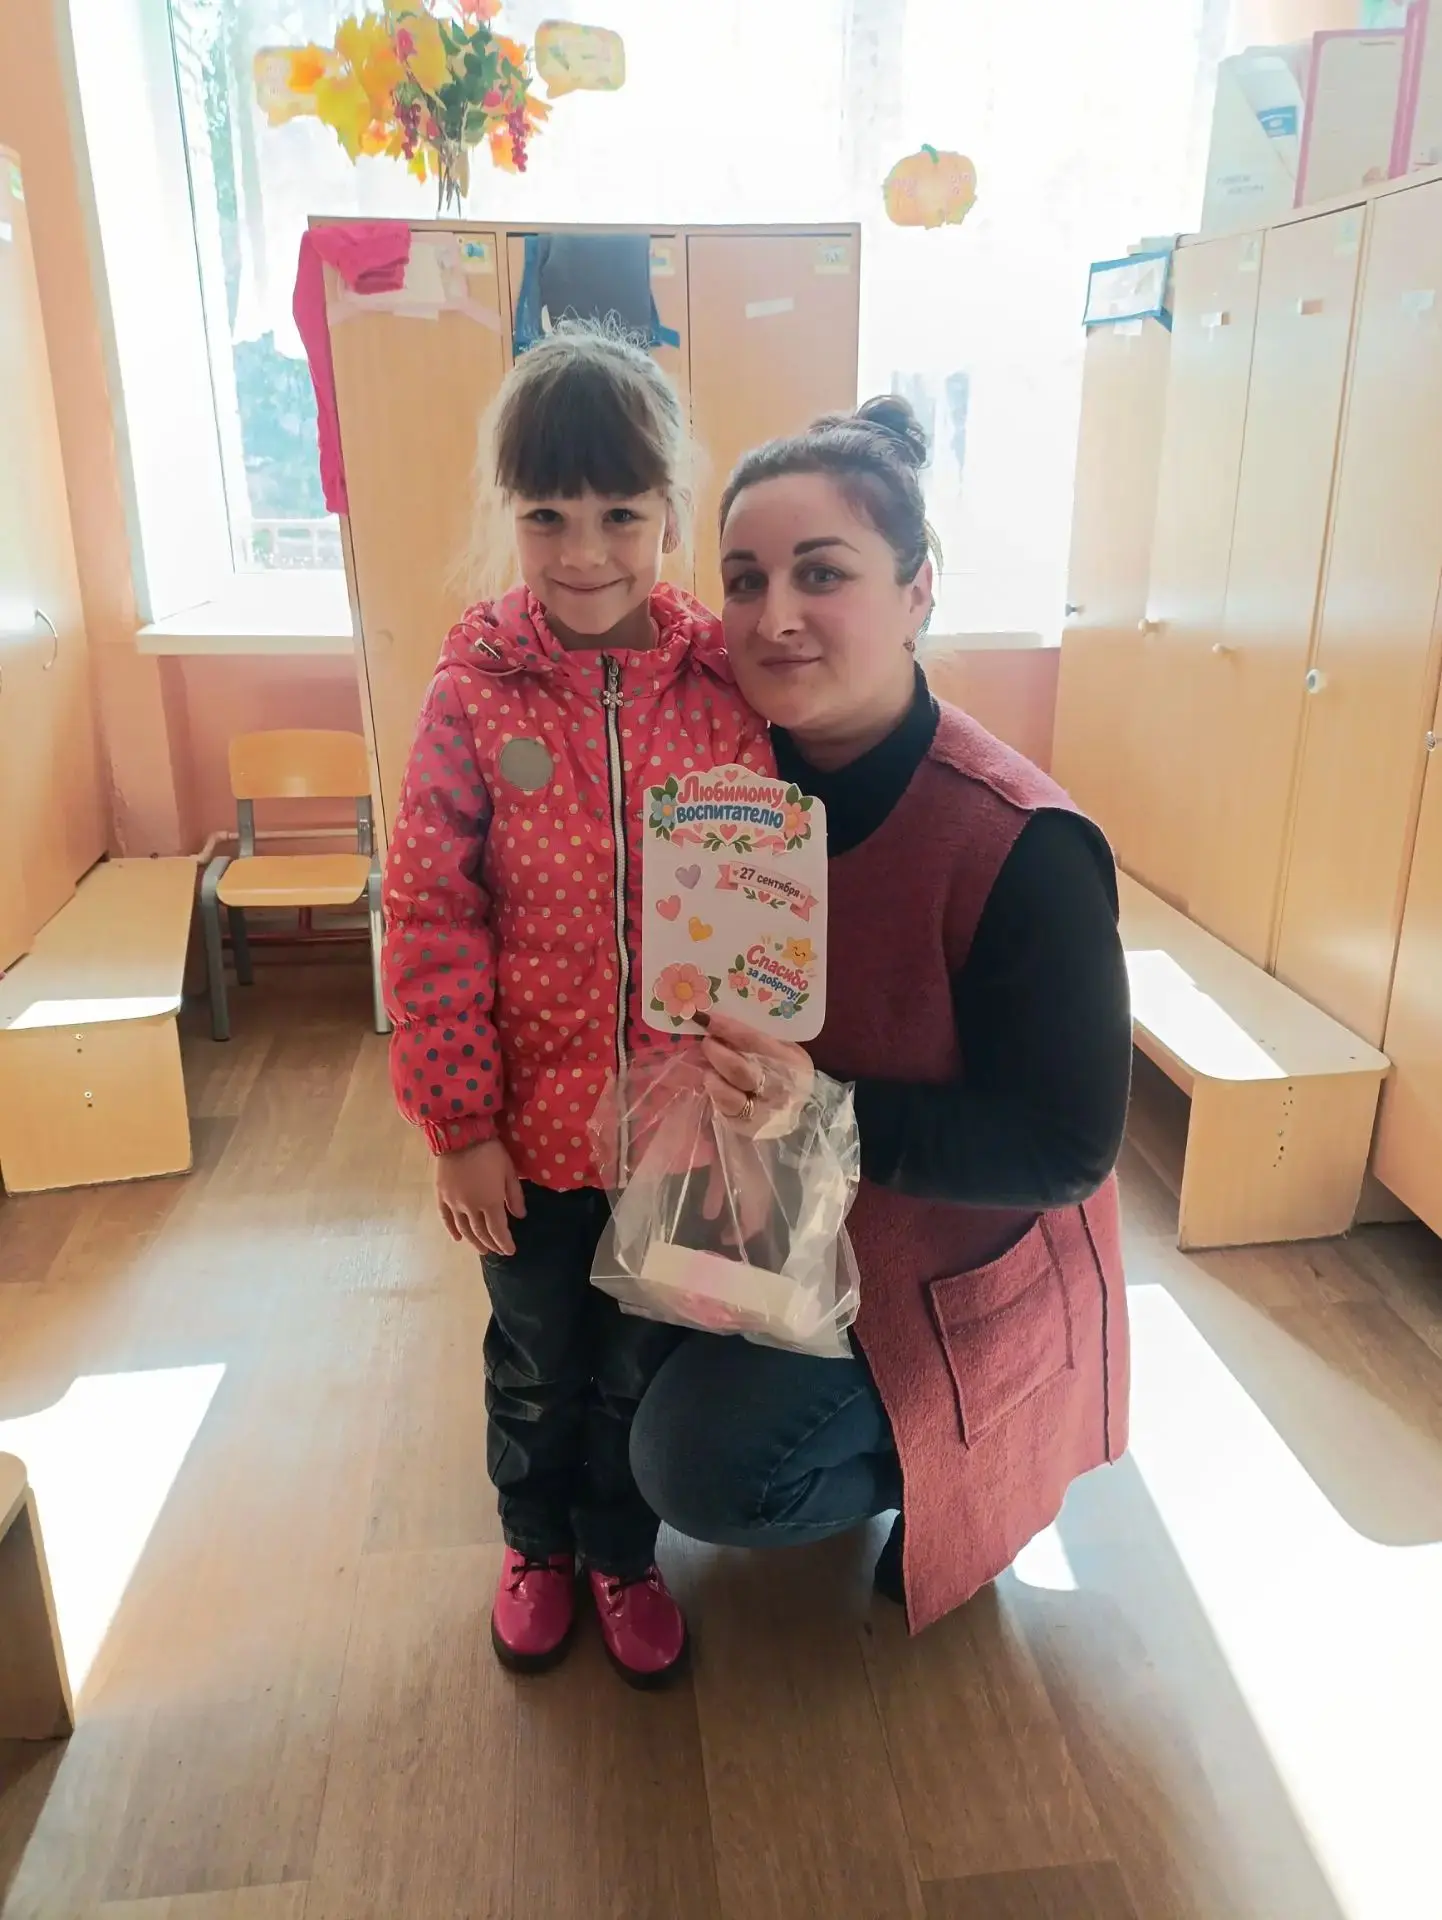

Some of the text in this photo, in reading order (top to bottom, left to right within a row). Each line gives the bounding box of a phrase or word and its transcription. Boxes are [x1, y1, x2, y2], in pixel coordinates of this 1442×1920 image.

[677, 775, 784, 808] Любимому
[676, 803, 784, 829] воспитателю
[739, 866, 800, 898] 27 сентября
[746, 944, 809, 992] Спасибо
[746, 966, 802, 1002] за доброту!
